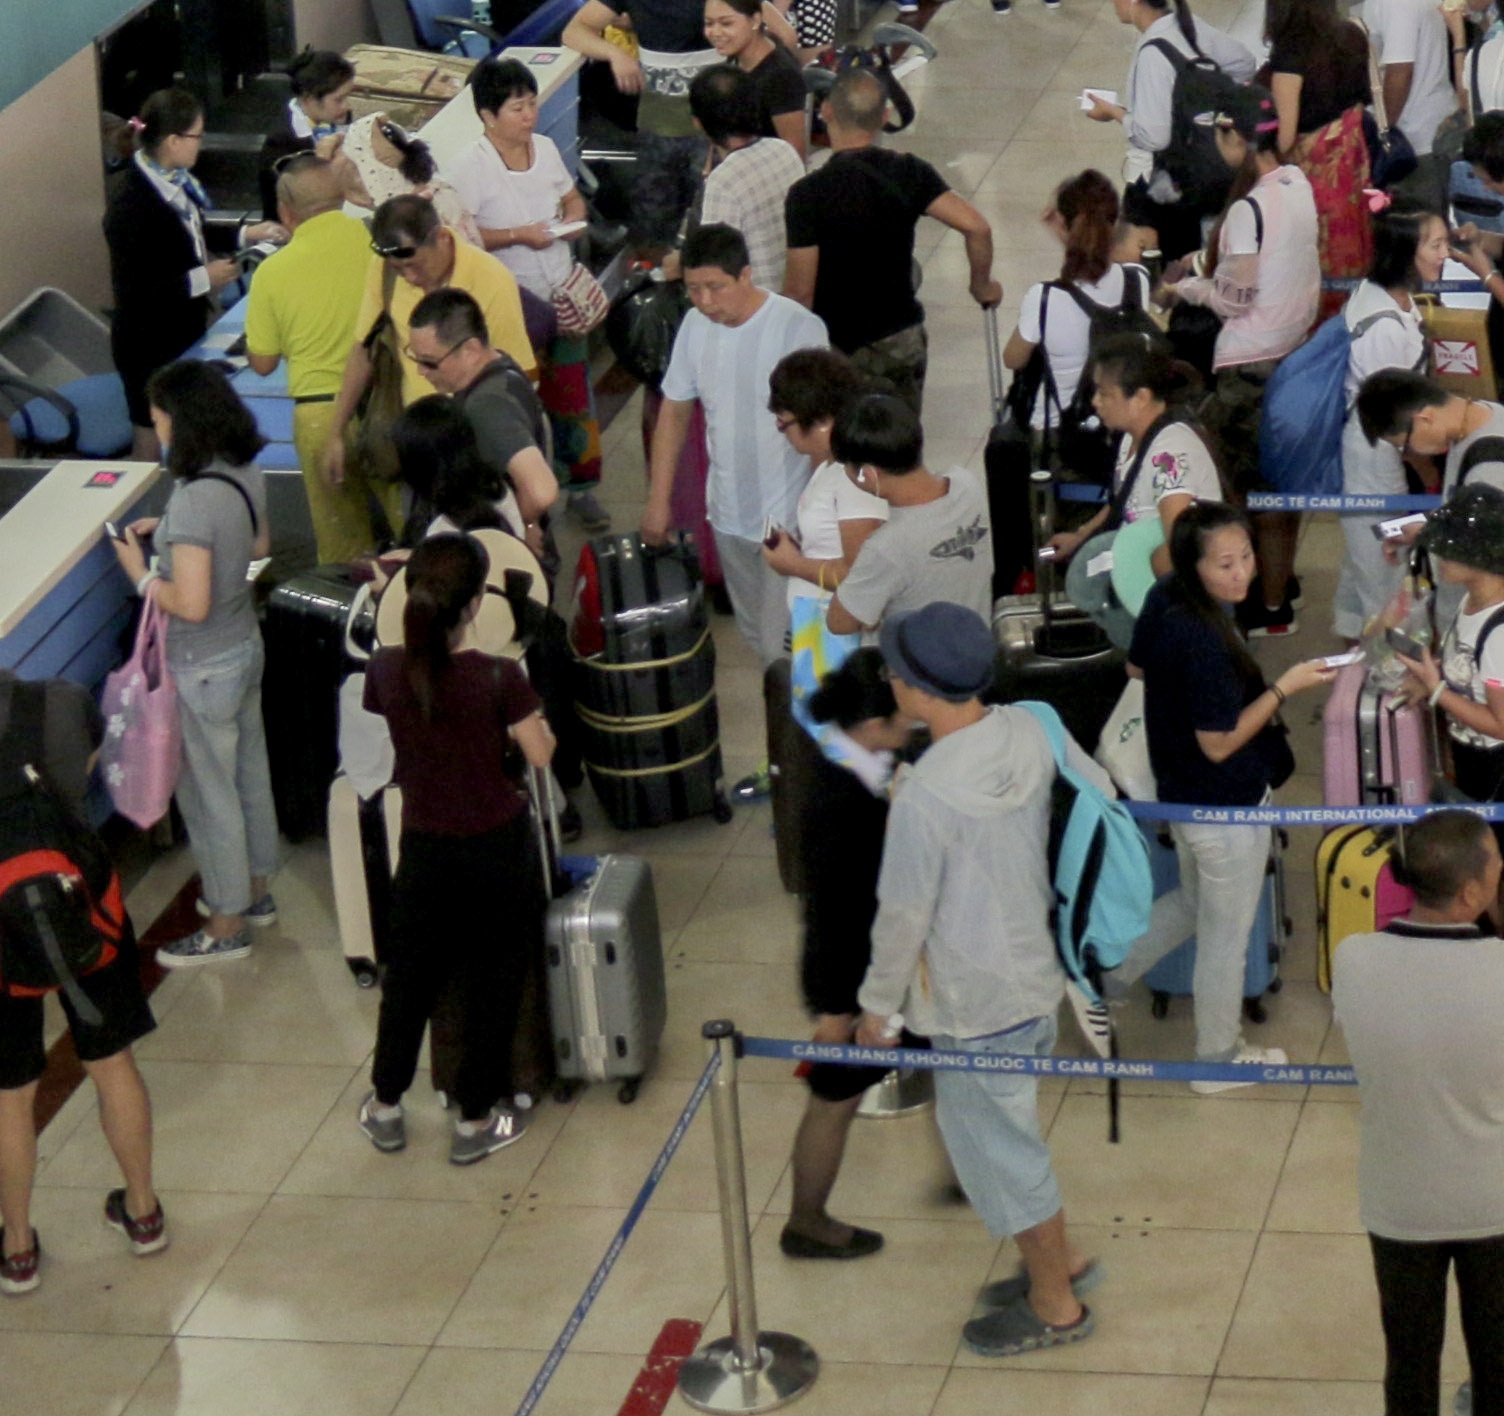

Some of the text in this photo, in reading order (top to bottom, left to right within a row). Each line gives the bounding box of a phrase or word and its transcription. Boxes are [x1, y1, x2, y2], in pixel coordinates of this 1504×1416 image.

[1310, 496, 1342, 509] CAM
[1345, 497, 1386, 510] RANH
[1192, 809, 1229, 822] CAM
[1235, 809, 1280, 822] RANH
[1285, 807, 1417, 822] INTERNATIONAL
[1058, 1060, 1099, 1073] CAM
[1103, 1062, 1154, 1076] RANH
[1263, 1068, 1304, 1081] CAM
[495, 1115, 513, 1136] N
